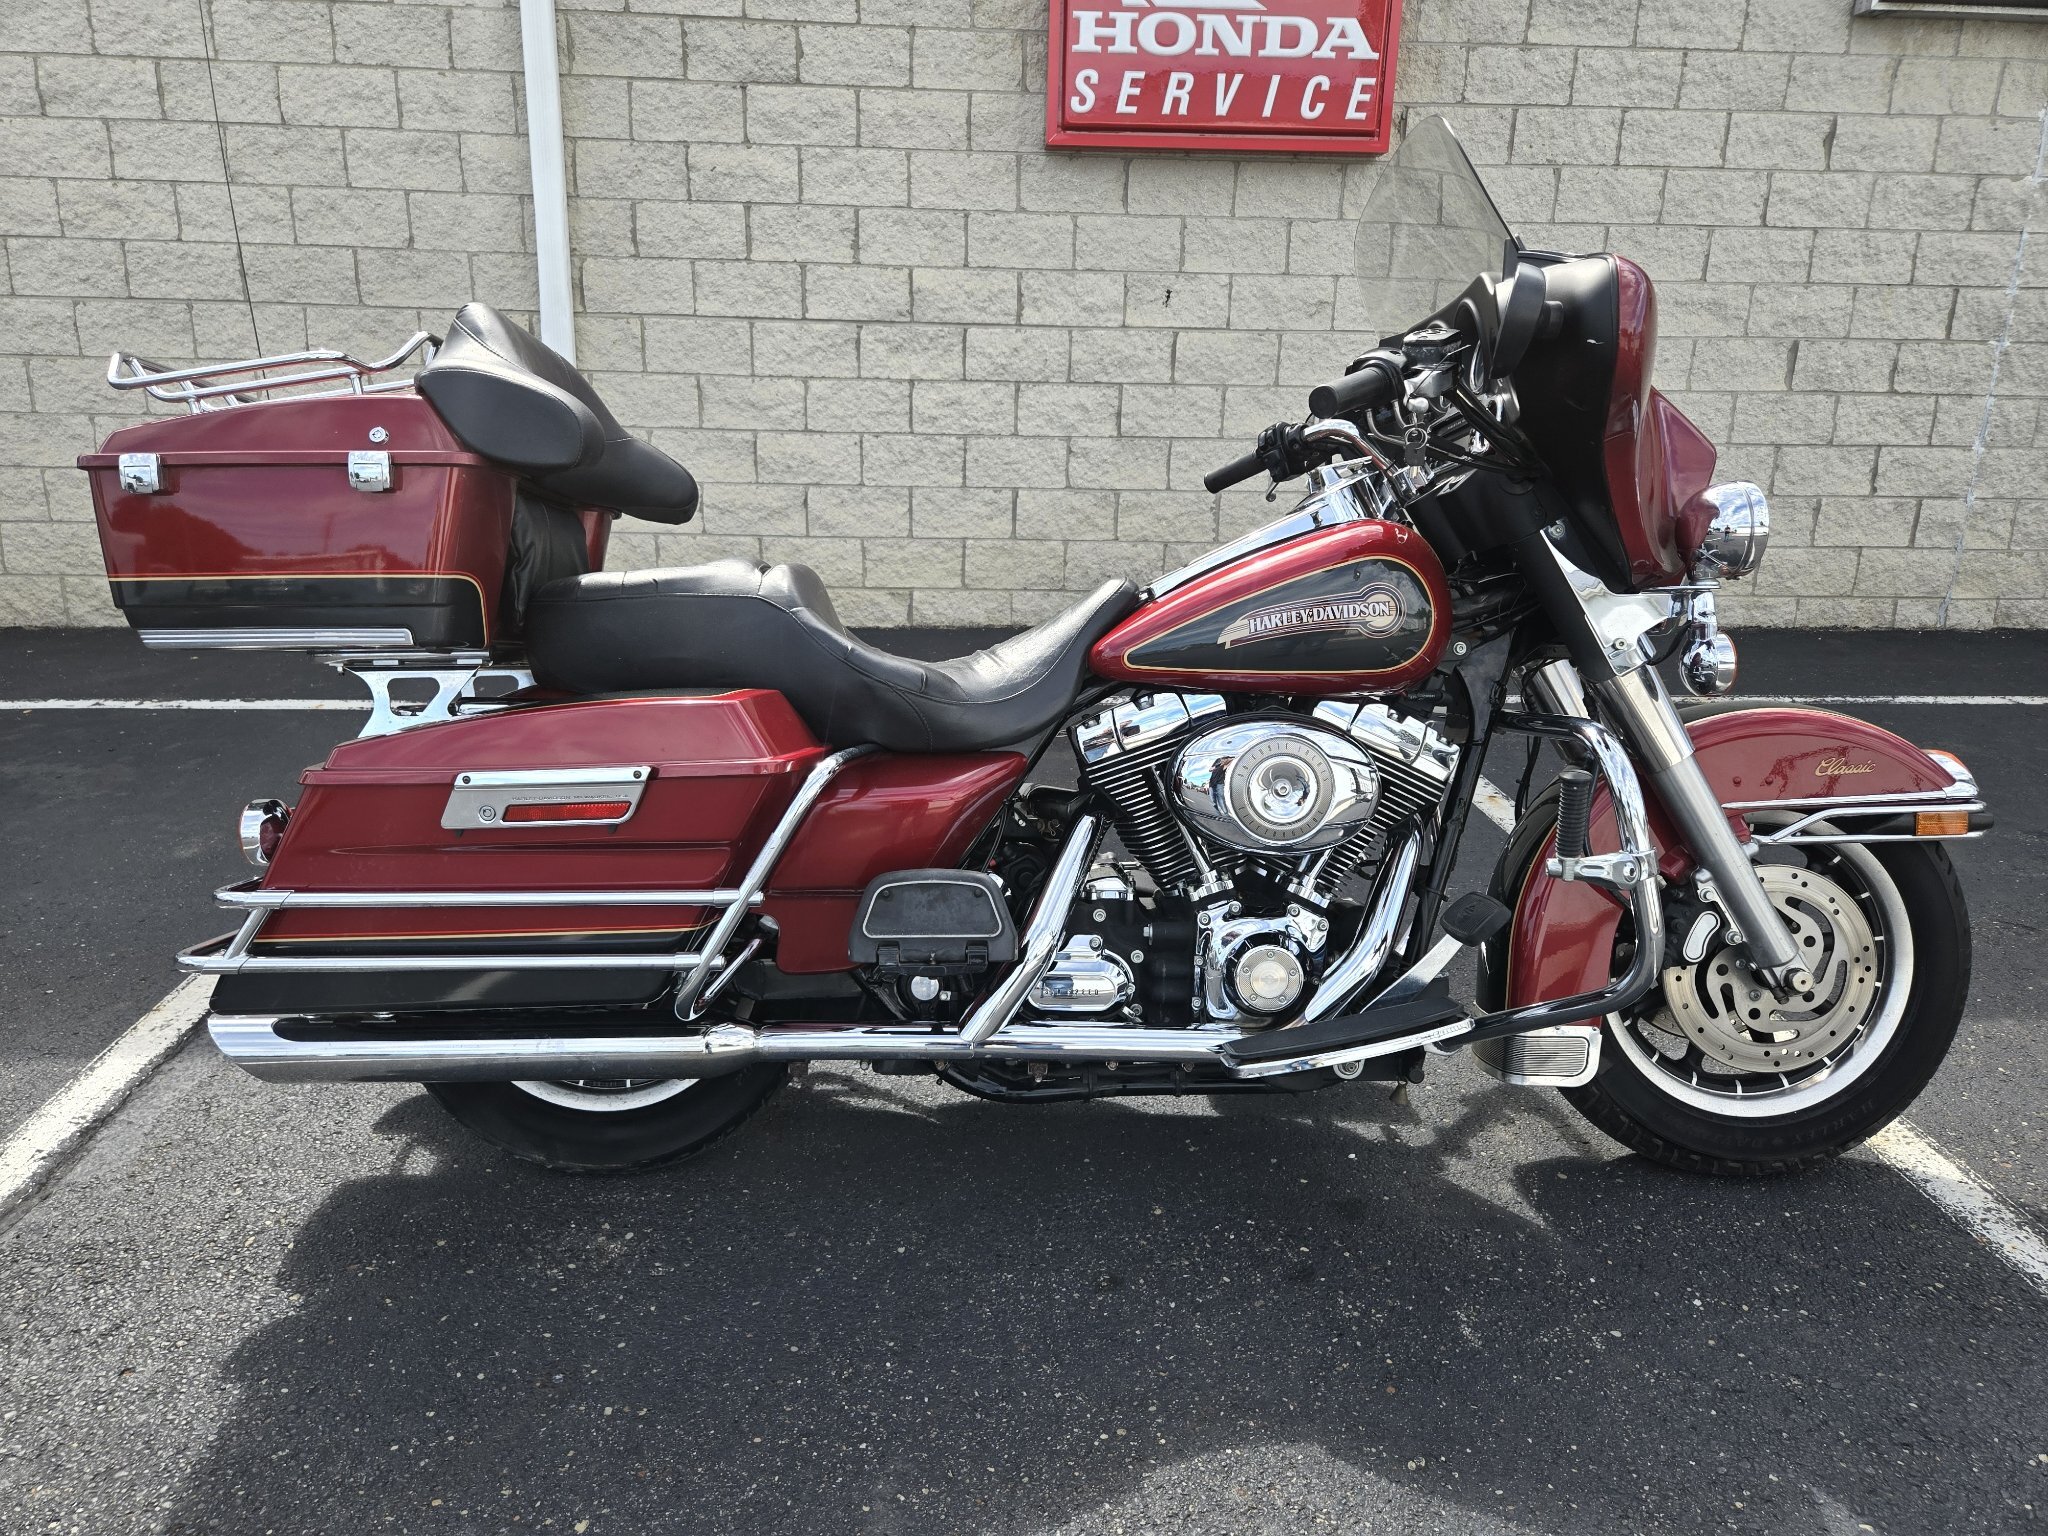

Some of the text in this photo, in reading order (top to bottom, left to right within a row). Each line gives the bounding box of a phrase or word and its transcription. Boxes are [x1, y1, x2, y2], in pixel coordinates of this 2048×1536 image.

[1071, 10, 1380, 60] HONDA
[1070, 68, 1378, 121] SERVICE
[1815, 757, 1876, 777] Classic
